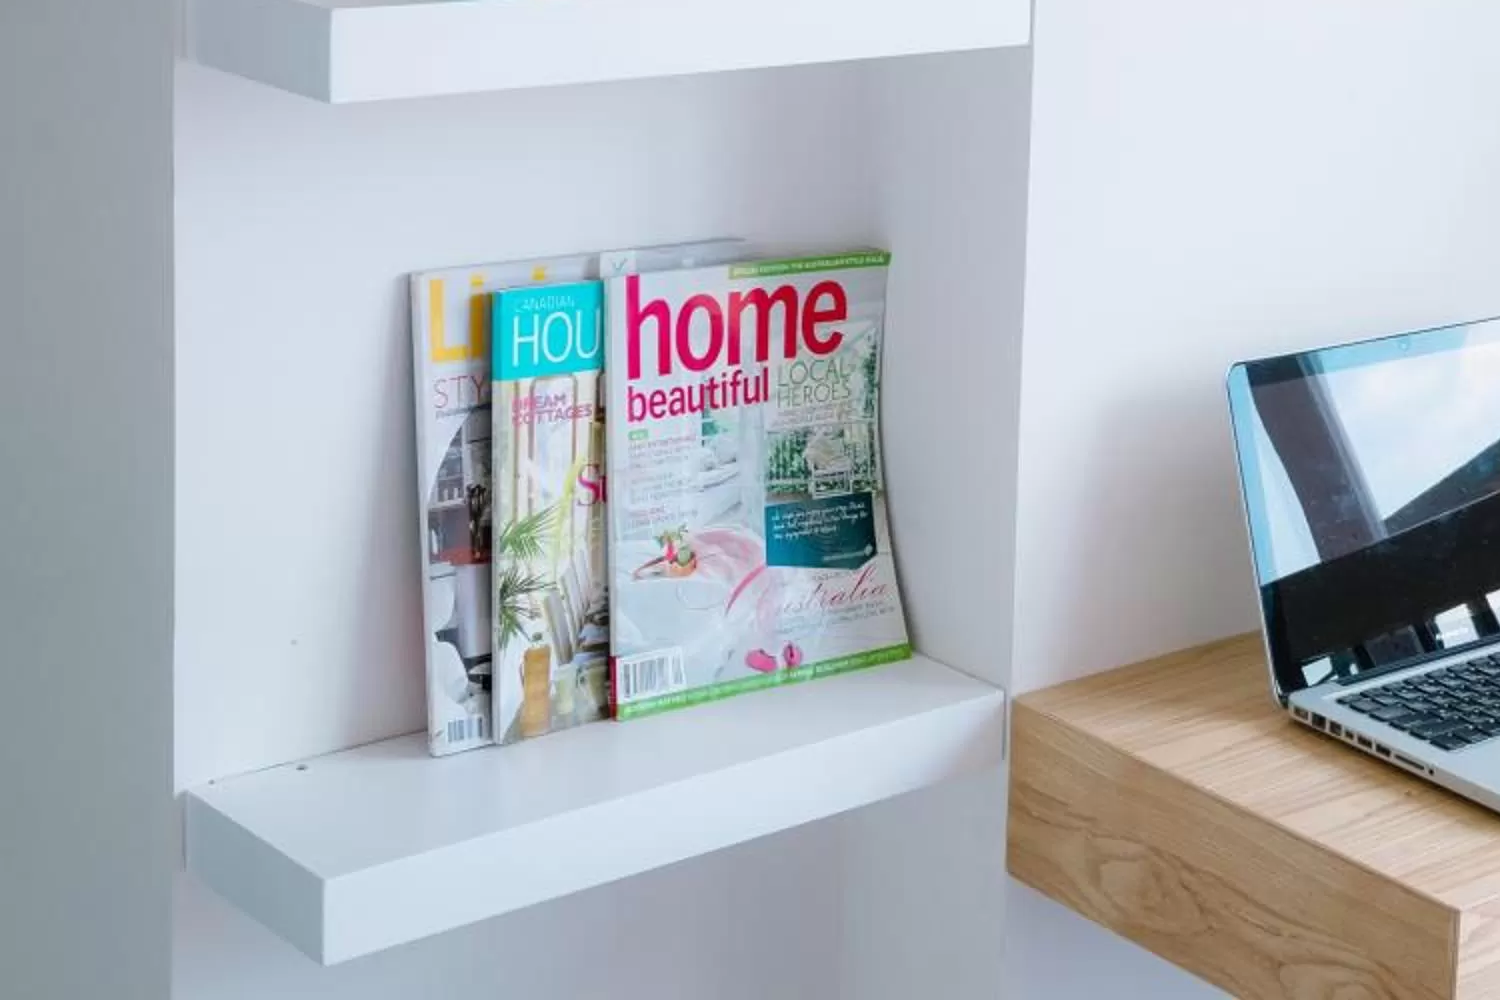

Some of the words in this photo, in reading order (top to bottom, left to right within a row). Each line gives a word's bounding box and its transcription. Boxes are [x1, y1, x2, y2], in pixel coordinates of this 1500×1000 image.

[515, 294, 575, 313] CANADIAN
[625, 274, 848, 380] home
[777, 358, 850, 386] LOCAL
[512, 393, 567, 411] DREAM
[627, 366, 769, 423] beautiful
[776, 380, 851, 408] HEROES
[513, 404, 593, 427] COTTAGES
